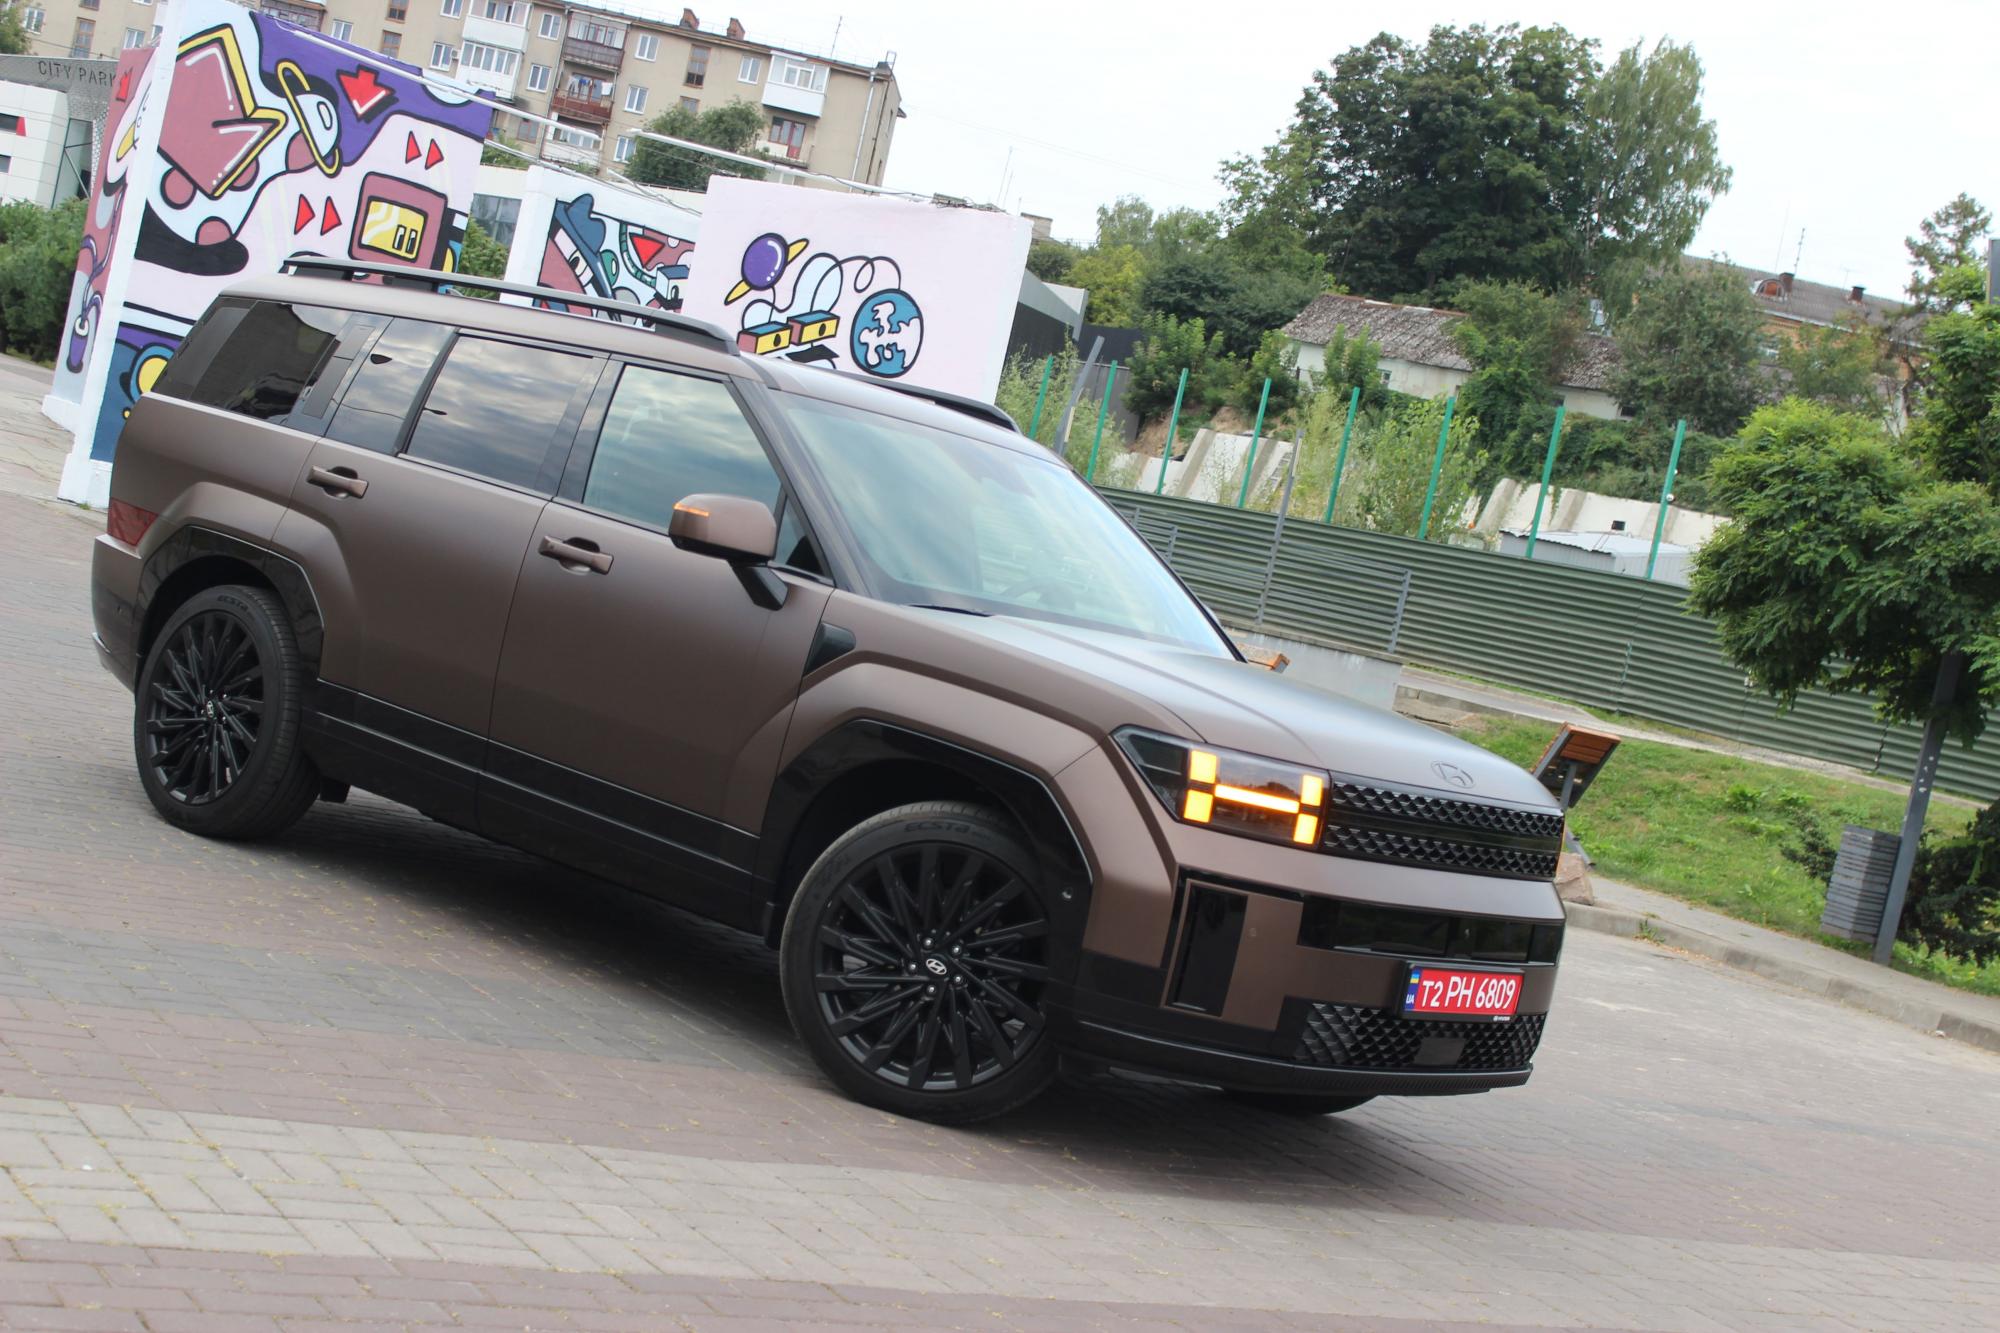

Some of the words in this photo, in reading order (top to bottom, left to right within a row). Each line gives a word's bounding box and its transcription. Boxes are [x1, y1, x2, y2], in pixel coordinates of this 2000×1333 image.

[38, 60, 71, 79] CITY
[1405, 993, 1415, 1005] UA
[1421, 980, 1444, 1008] T2
[1444, 975, 1476, 1008] PH
[1475, 977, 1517, 1010] 6809
